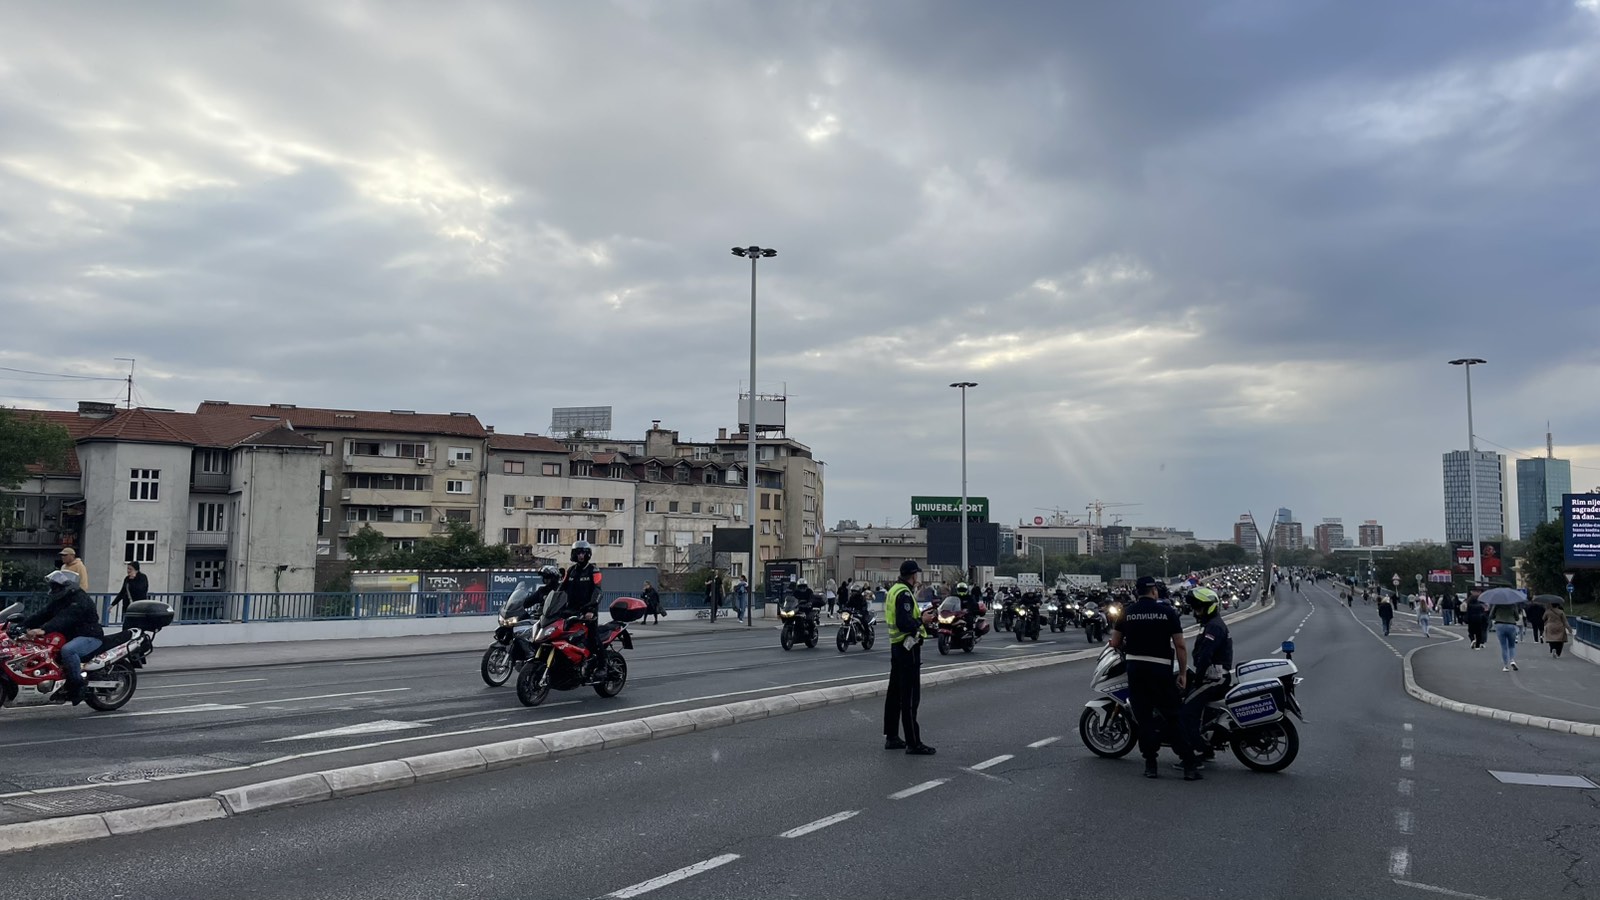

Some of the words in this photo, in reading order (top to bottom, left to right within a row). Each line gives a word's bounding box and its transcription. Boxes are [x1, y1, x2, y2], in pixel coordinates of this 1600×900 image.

[494, 575, 517, 583] Diplon
[1126, 613, 1168, 621] ПОЛИЦИЈА
[1236, 705, 1274, 717] ПОЛИЦИЈА
